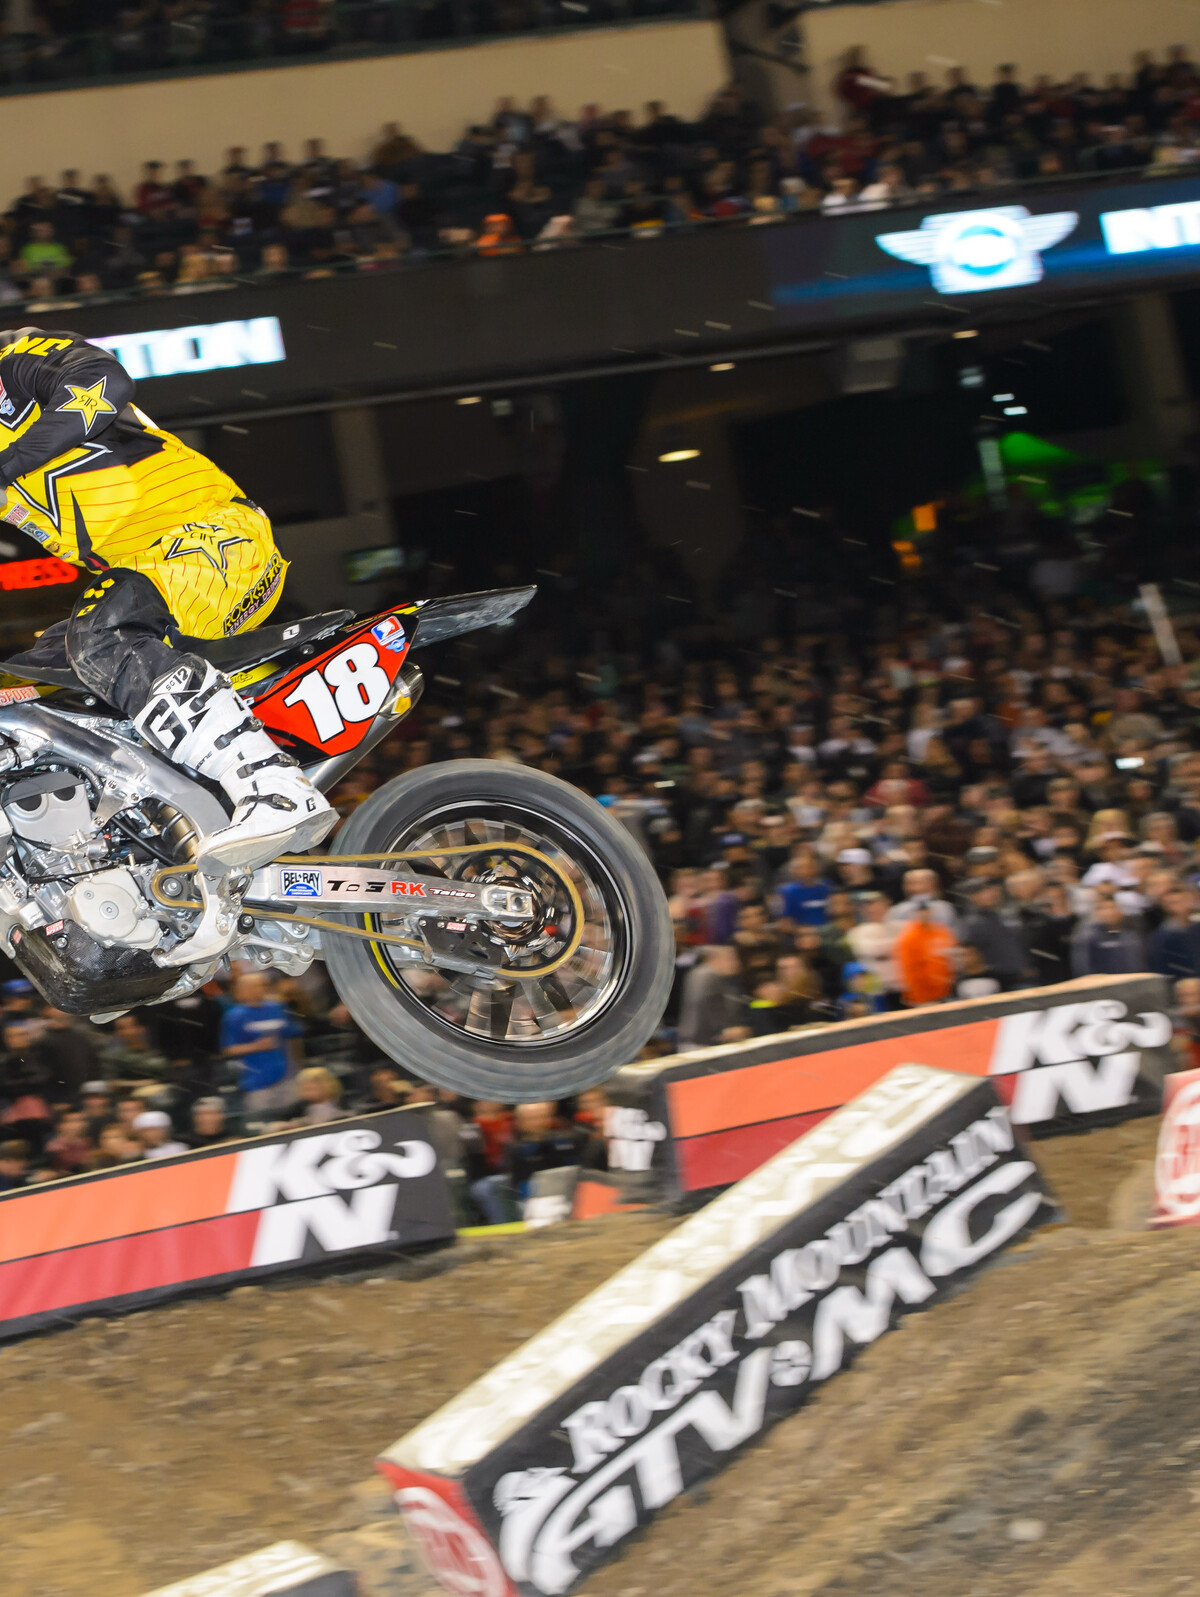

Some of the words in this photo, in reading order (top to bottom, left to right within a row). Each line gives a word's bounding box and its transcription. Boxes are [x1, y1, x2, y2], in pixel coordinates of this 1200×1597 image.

[285, 642, 391, 743] 18
[391, 881, 426, 897] RK
[561, 1309, 741, 1473] ROCKY
[737, 1106, 1014, 1340] MOUNTAIN
